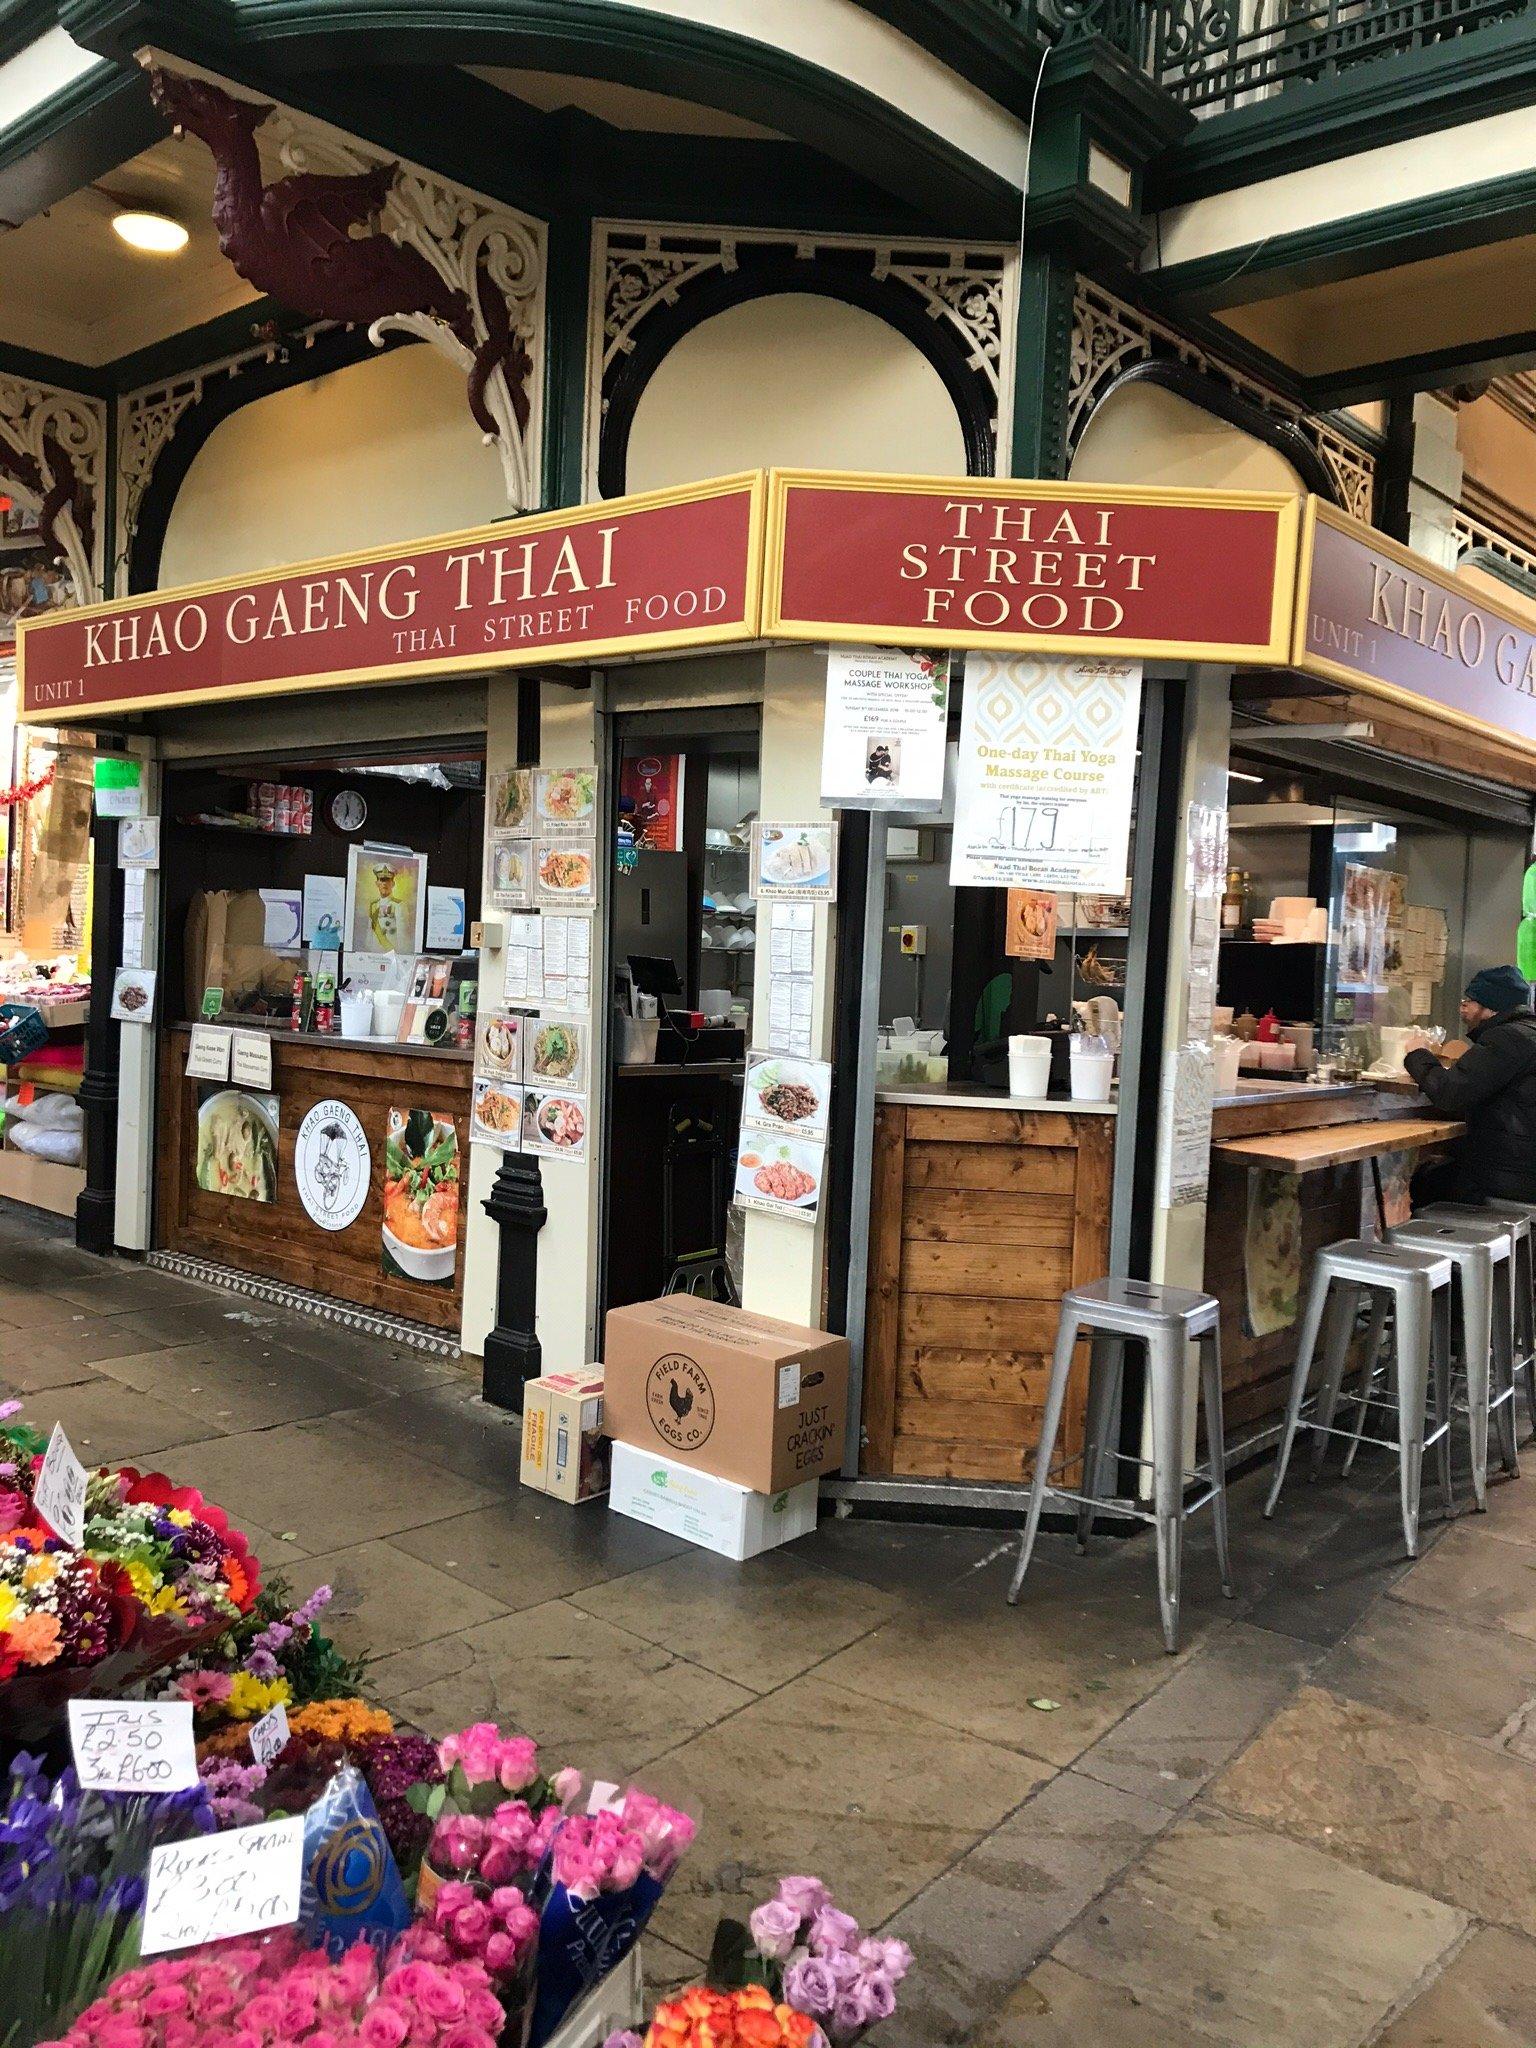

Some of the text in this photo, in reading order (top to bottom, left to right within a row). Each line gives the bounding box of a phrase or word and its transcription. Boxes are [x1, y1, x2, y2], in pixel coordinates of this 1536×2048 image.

[944, 501, 1115, 546] THAI
[899, 543, 1157, 592] STREET
[83, 526, 620, 668] KHAO GAENG THAI
[921, 587, 1125, 633] FOOD
[393, 586, 728, 654] THAI STREET FOOD
[1366, 562, 1485, 668] KHAO
[1312, 614, 1377, 664] UNIT 1
[34, 677, 86, 702] UNIT 1
[844, 679, 932, 690] MASSAGE WORKSHOP
[849, 669, 928, 681] COUPLE THAI YOGA
[977, 745, 1116, 767] One-day Thai Yoga
[985, 764, 1105, 782] Massage Course
[1050, 867, 1080, 875] Academy
[300, 1104, 369, 1159] KHAO GAENG THAI
[341, 1203, 359, 1218] FOOD
[655, 1360, 707, 1395] FIELD FARM
[658, 1417, 683, 1442] EGGS
[798, 1405, 829, 1429] JUST
[529, 1412, 538, 1461] FRAGILE
[795, 1445, 825, 1470] EGGS
